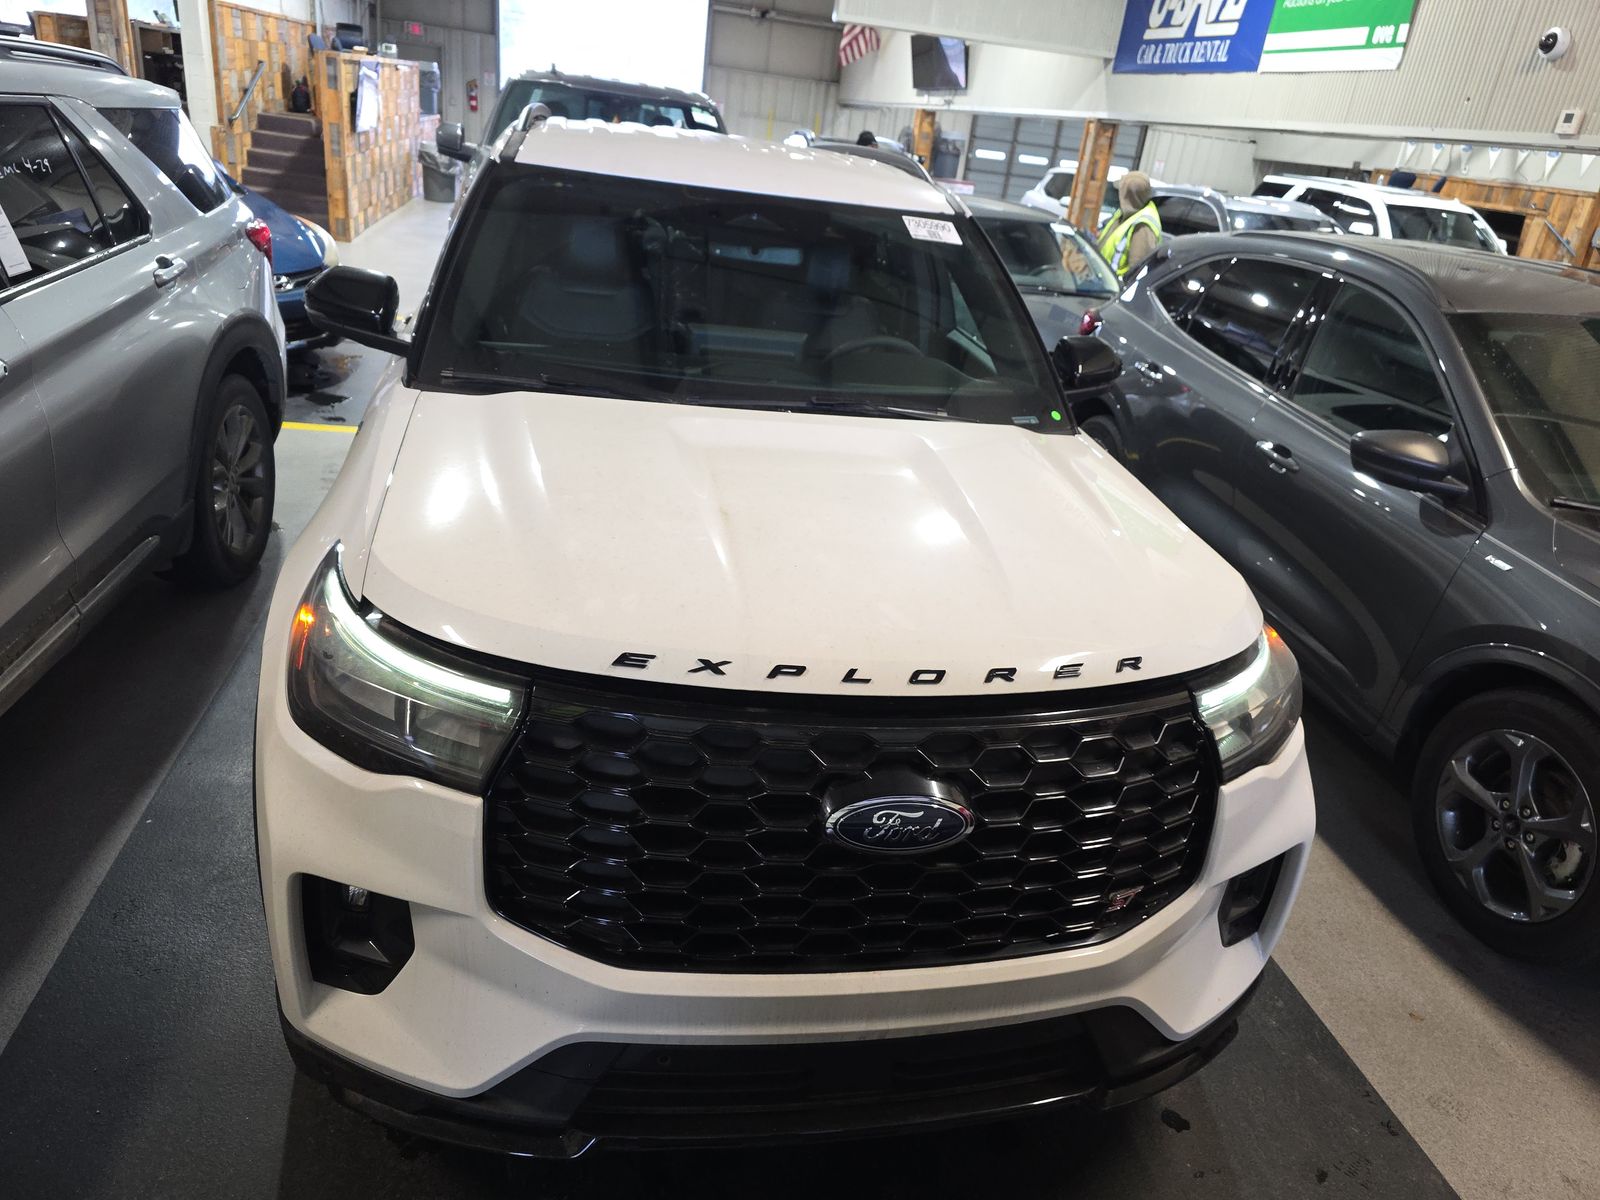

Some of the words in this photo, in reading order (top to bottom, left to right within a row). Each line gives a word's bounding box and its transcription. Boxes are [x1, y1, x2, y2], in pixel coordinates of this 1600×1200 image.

[1136, 44, 1156, 65] CAR
[1161, 41, 1195, 64] TRUCK
[1190, 39, 1231, 63] RENTAL
[611, 651, 1143, 685] EXPLORER
[863, 809, 944, 842] Ford
[1106, 885, 1145, 913] ST
